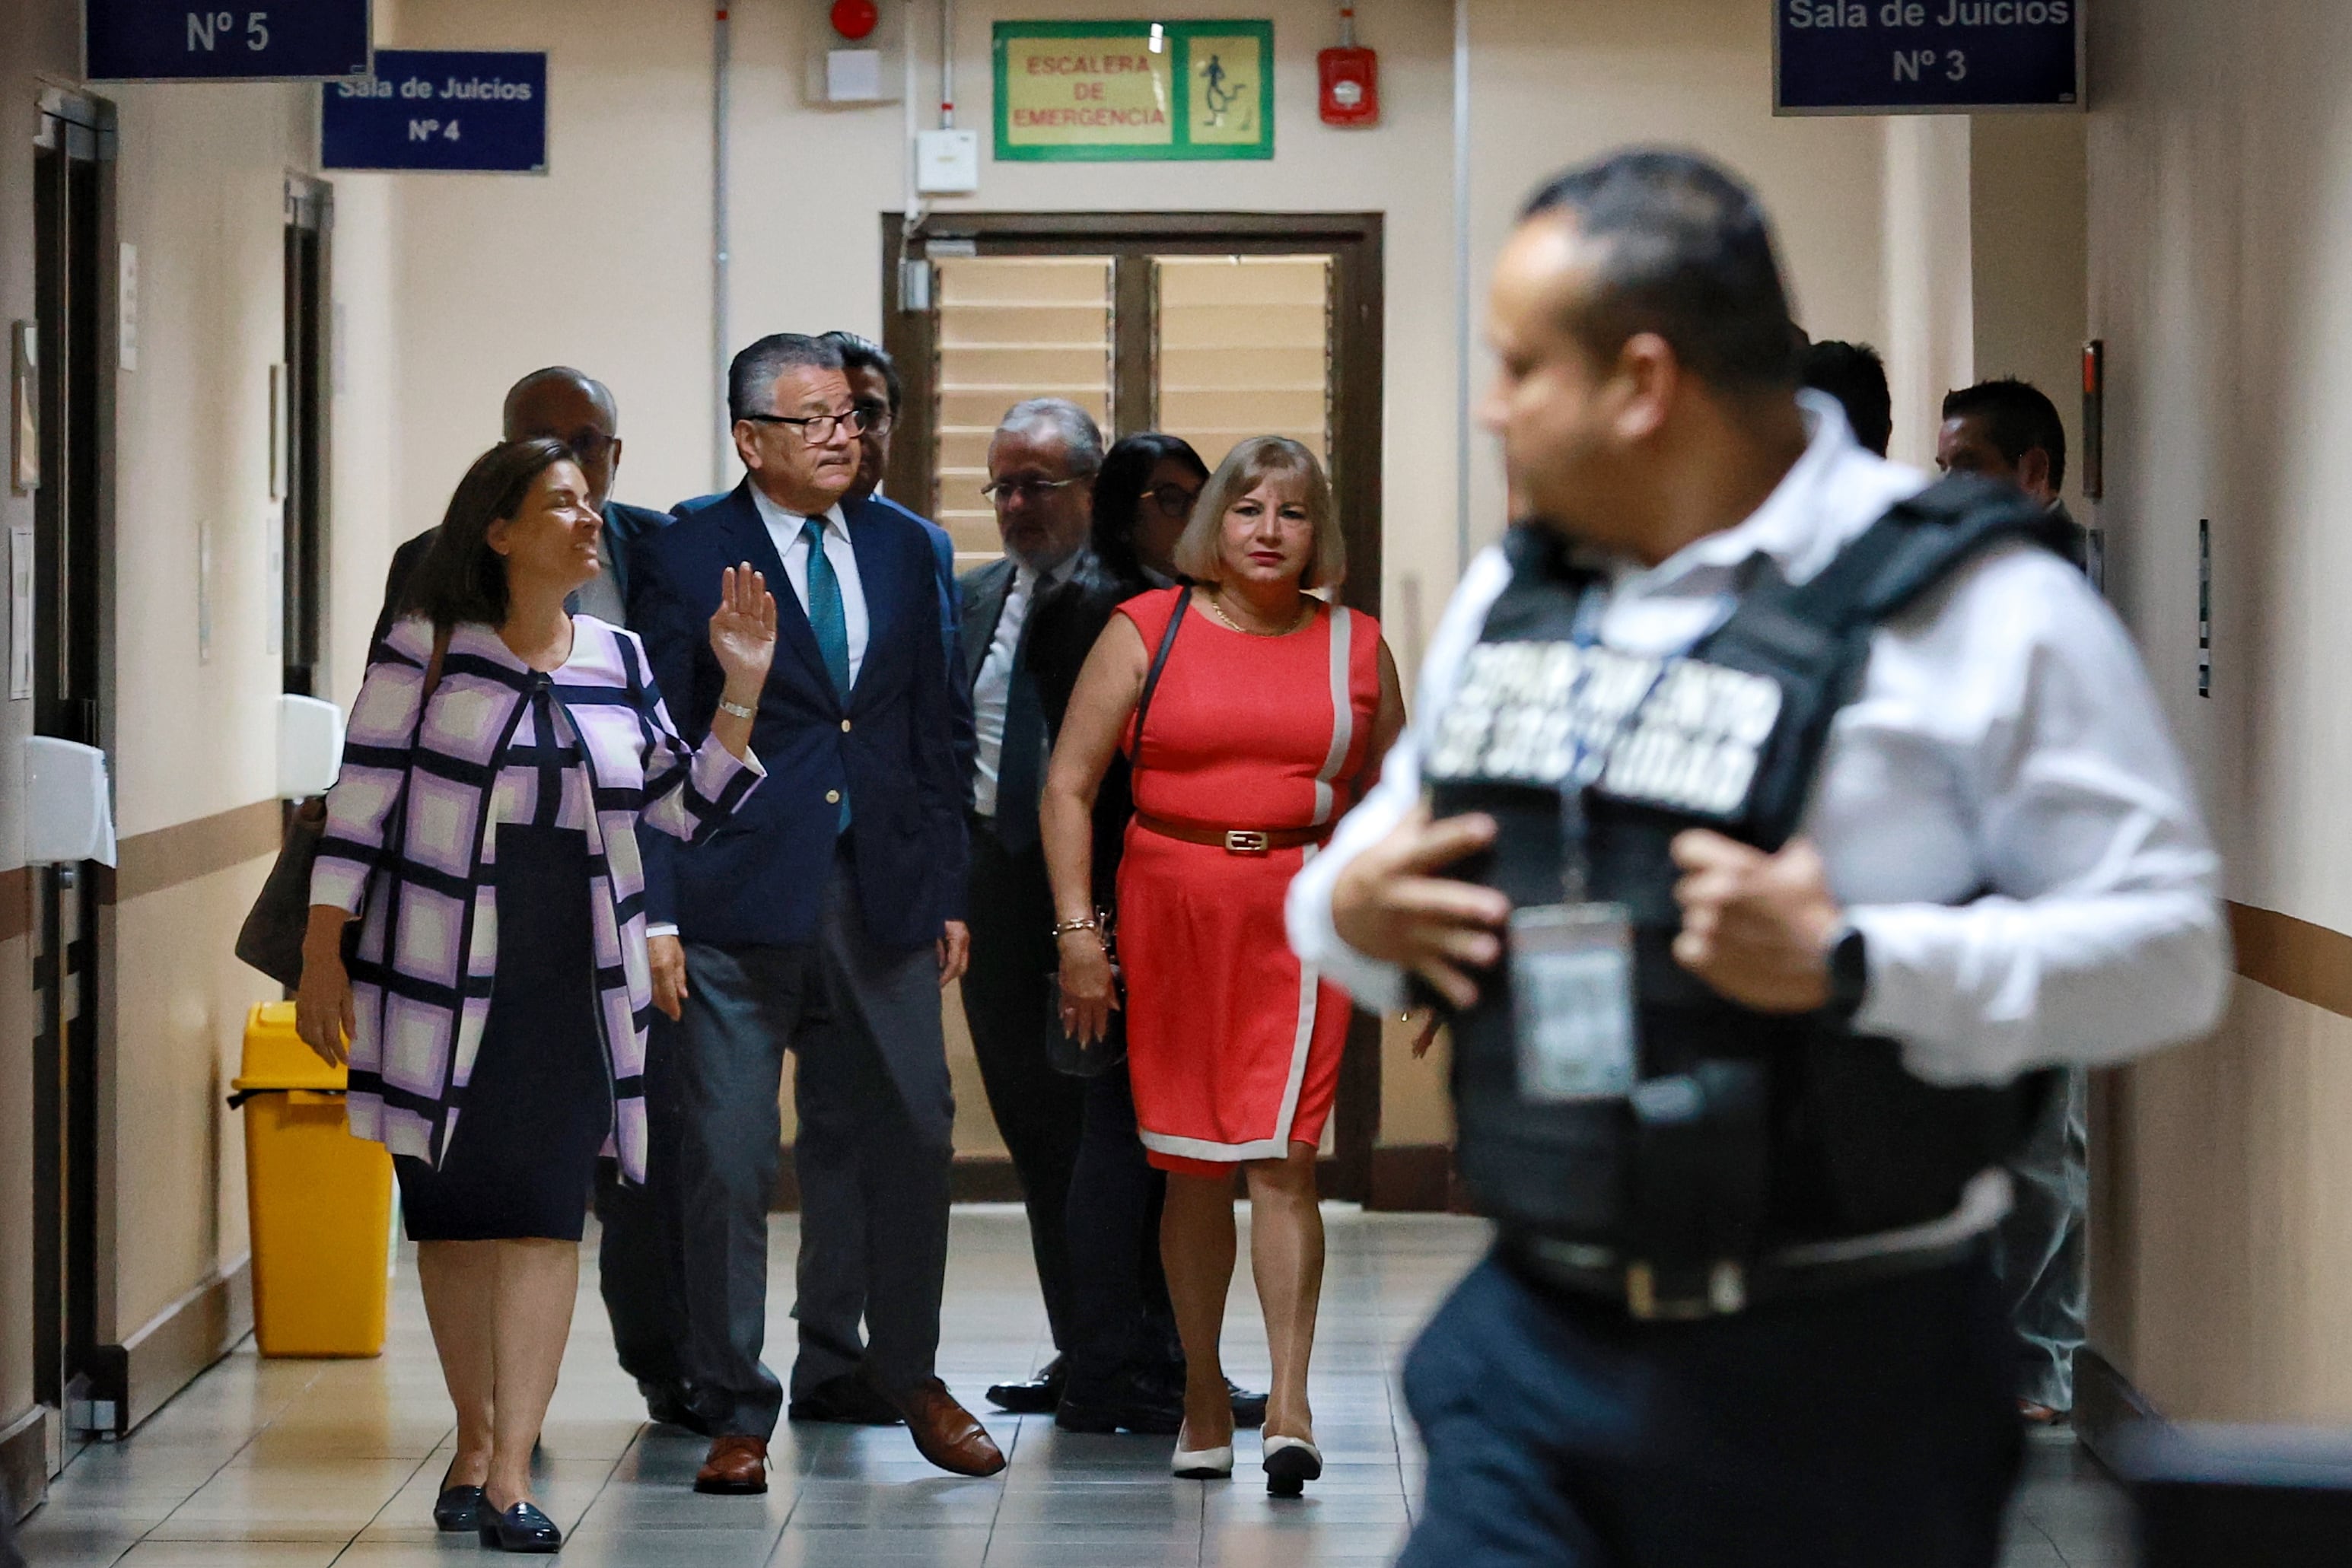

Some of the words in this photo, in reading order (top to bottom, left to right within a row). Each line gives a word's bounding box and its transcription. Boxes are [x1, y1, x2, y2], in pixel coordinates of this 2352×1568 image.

[1789, 0, 1868, 27] Sala
[1880, 0, 1925, 27] de
[1937, 0, 2070, 27] Juicios
[247, 12, 269, 51] 5
[1026, 56, 1150, 75] ESCALERA
[1945, 49, 1967, 81] 3
[338, 79, 393, 98] Sala
[400, 77, 433, 99] de
[439, 77, 532, 100] Juicios
[1074, 82, 1105, 100] DE
[1013, 108, 1165, 128] EMERGENCIA
[443, 119, 460, 141] 4
